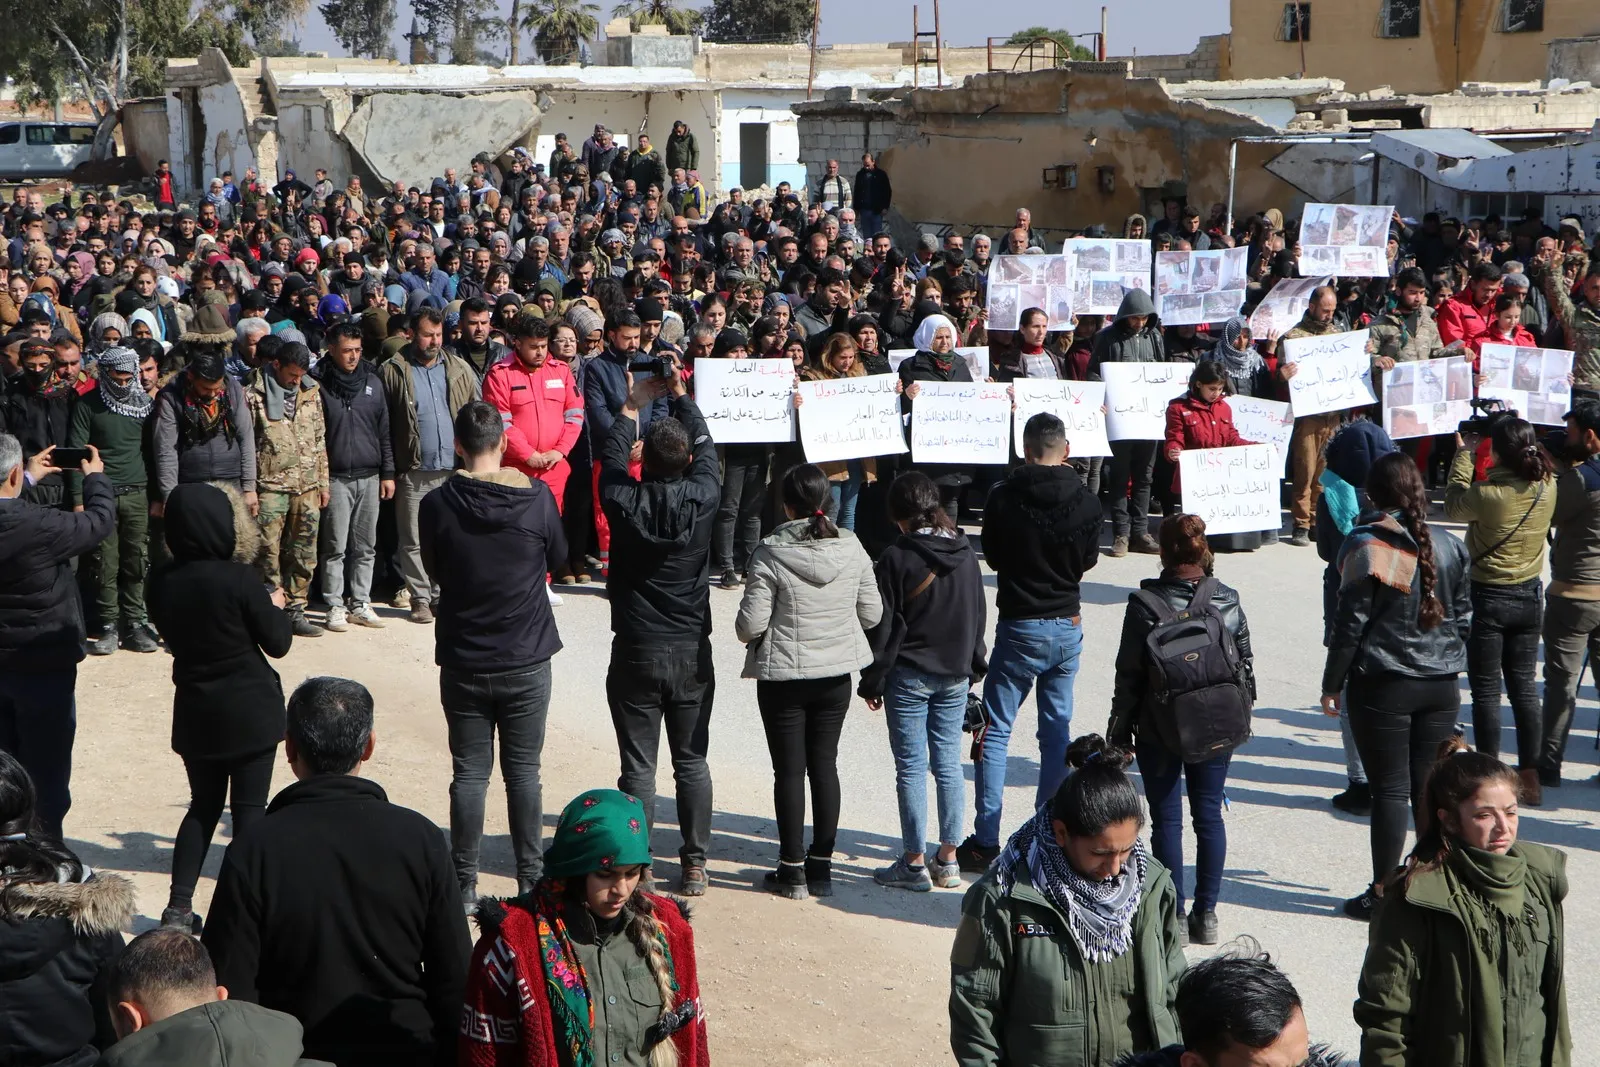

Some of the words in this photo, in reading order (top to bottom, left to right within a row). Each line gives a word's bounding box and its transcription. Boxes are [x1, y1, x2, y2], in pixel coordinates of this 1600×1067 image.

[728, 361, 757, 374] الحصار
[1130, 366, 1174, 386] للحصار
[720, 383, 749, 398] الكارثة
[751, 390, 764, 398] من
[920, 386, 956, 398] مساعدة
[1071, 391, 1084, 405] لا
[733, 407, 747, 421] على
[1114, 397, 1149, 417] الشعب
[1154, 400, 1166, 418] لى
[975, 412, 1006, 425] الشعب
[1252, 448, 1271, 471] أين
[1233, 480, 1272, 496] المنظمات
